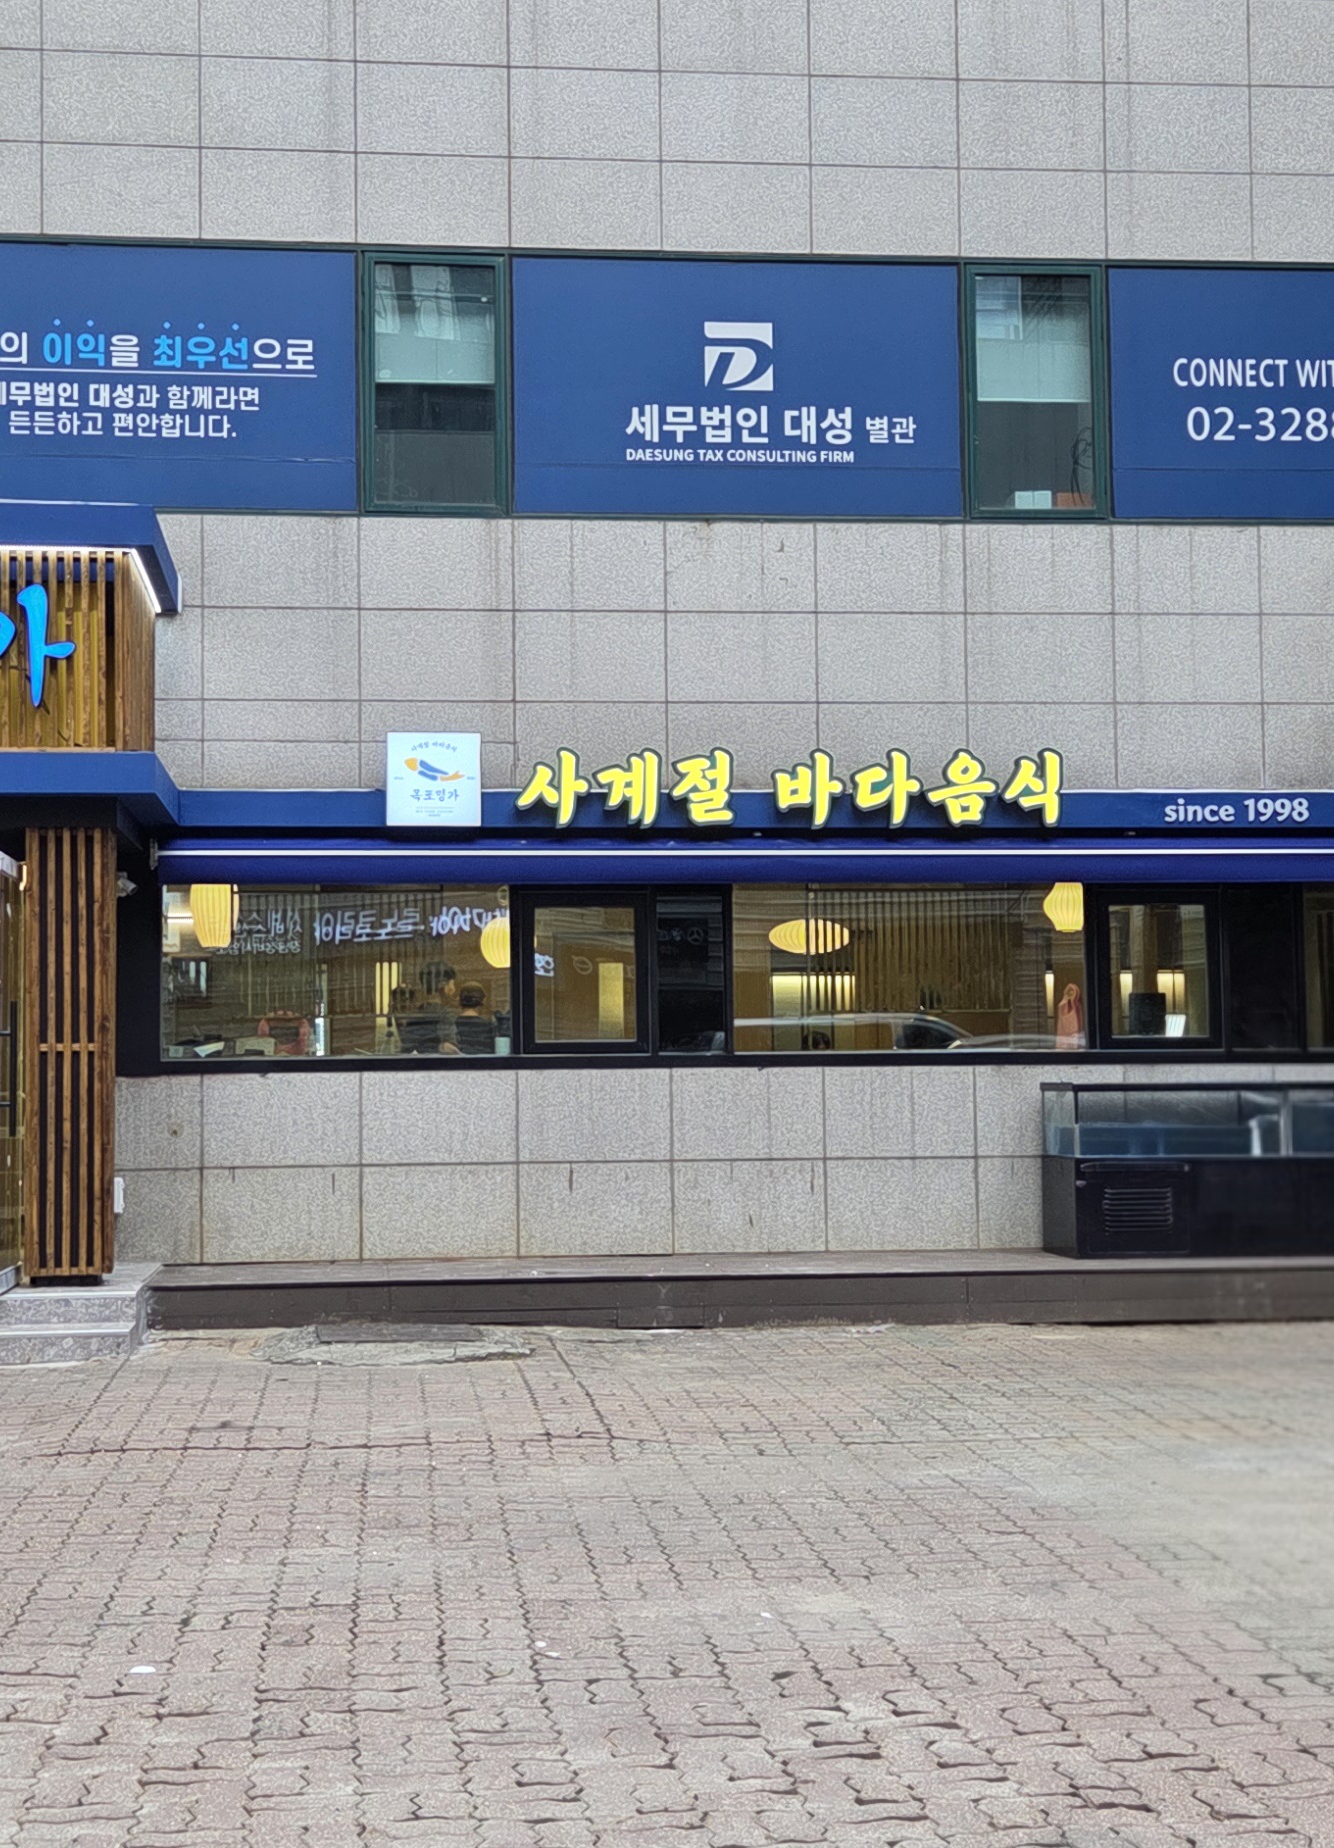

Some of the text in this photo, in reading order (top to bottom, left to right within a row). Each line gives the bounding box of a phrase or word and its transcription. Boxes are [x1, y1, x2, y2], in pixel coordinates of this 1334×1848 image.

[42, 331, 140, 368] 이익을
[153, 334, 315, 371] 최우선으로
[1173, 358, 1288, 388] CONNECT
[89, 383, 160, 409] 대성과
[167, 384, 260, 412] 함께라면
[8, 410, 237, 439] 든든하고 편안합니다.
[625, 404, 916, 445] 세무법인 대성 별관
[626, 448, 854, 463] DAESUNG TAX CONSULTING FIRM
[516, 747, 1065, 829] 사계절 바다음식
[1164, 798, 1235, 822] since
[1243, 797, 1309, 822] 1998
